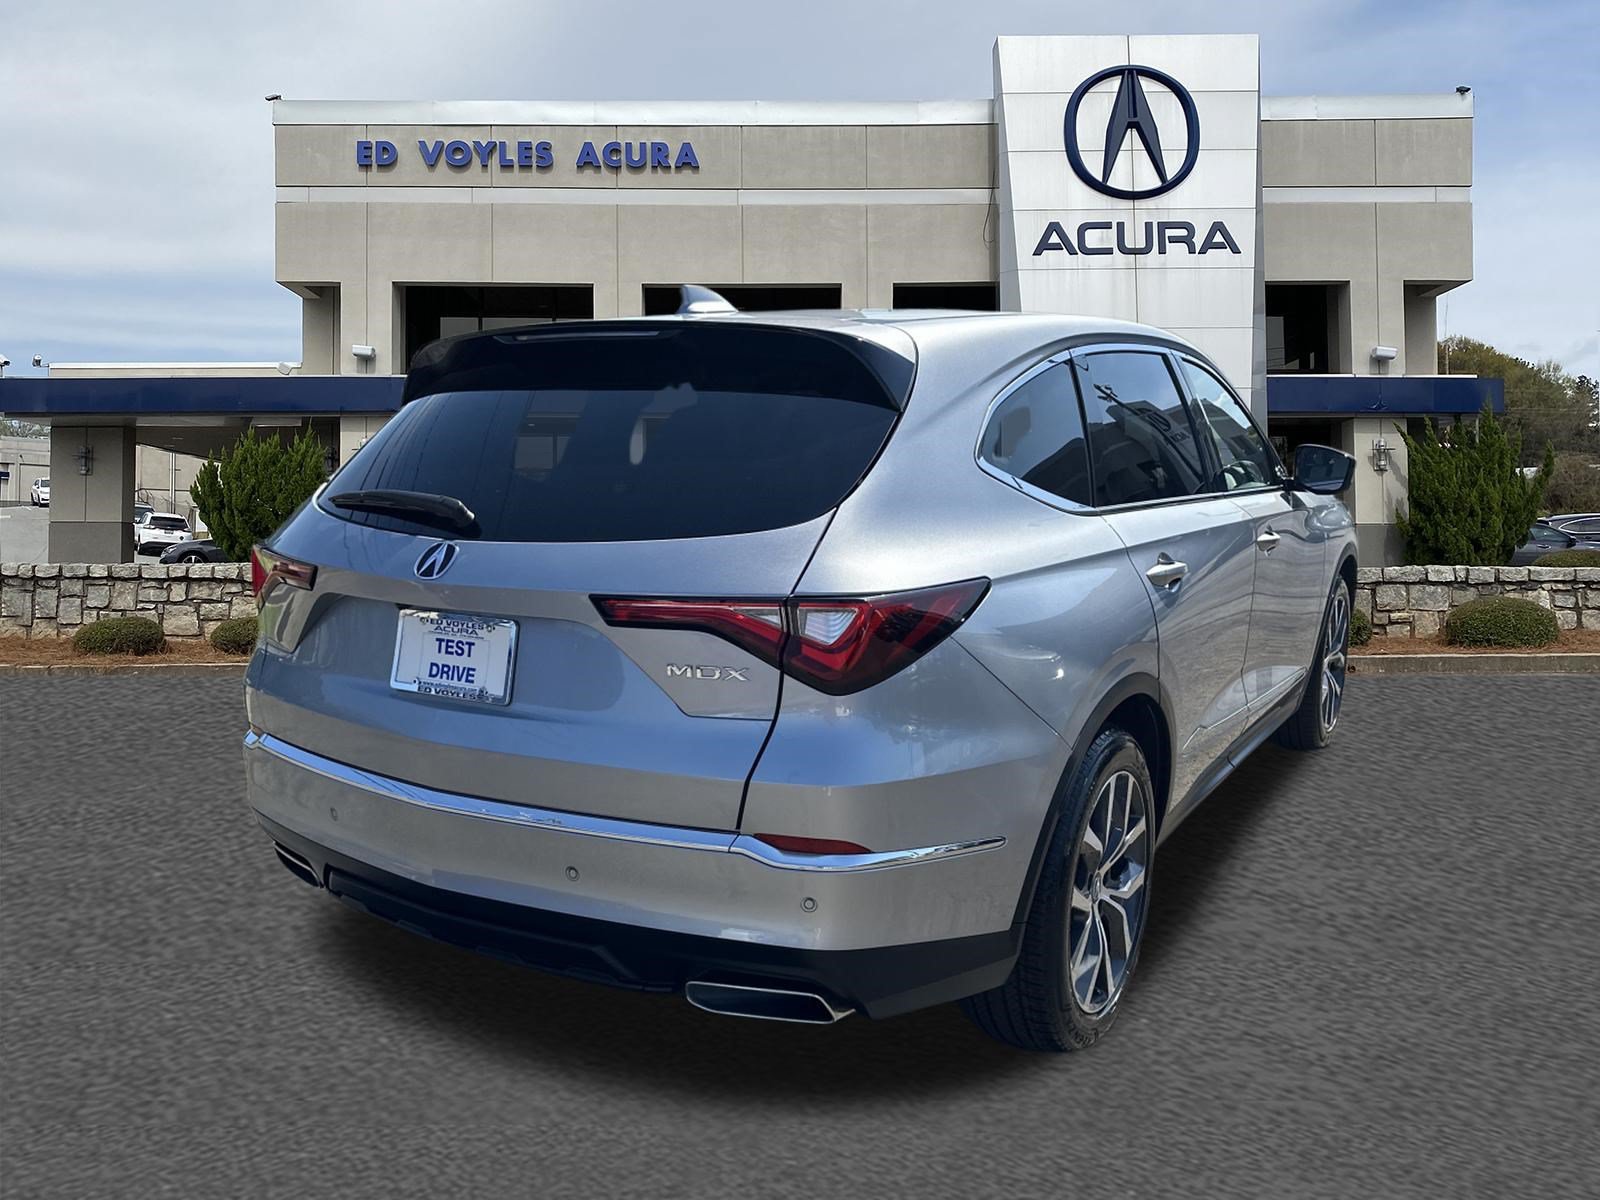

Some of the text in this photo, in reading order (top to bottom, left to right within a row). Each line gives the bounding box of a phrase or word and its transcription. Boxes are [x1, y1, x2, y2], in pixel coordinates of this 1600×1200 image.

[356, 139, 701, 169] ED VOYLES ACURA
[1031, 220, 1242, 256] ACURA
[430, 618, 485, 631] ED VOYLES
[433, 625, 479, 637] ACURA
[435, 637, 475, 658] TEST
[428, 661, 477, 684] DRIVE
[666, 663, 751, 681] MDX
